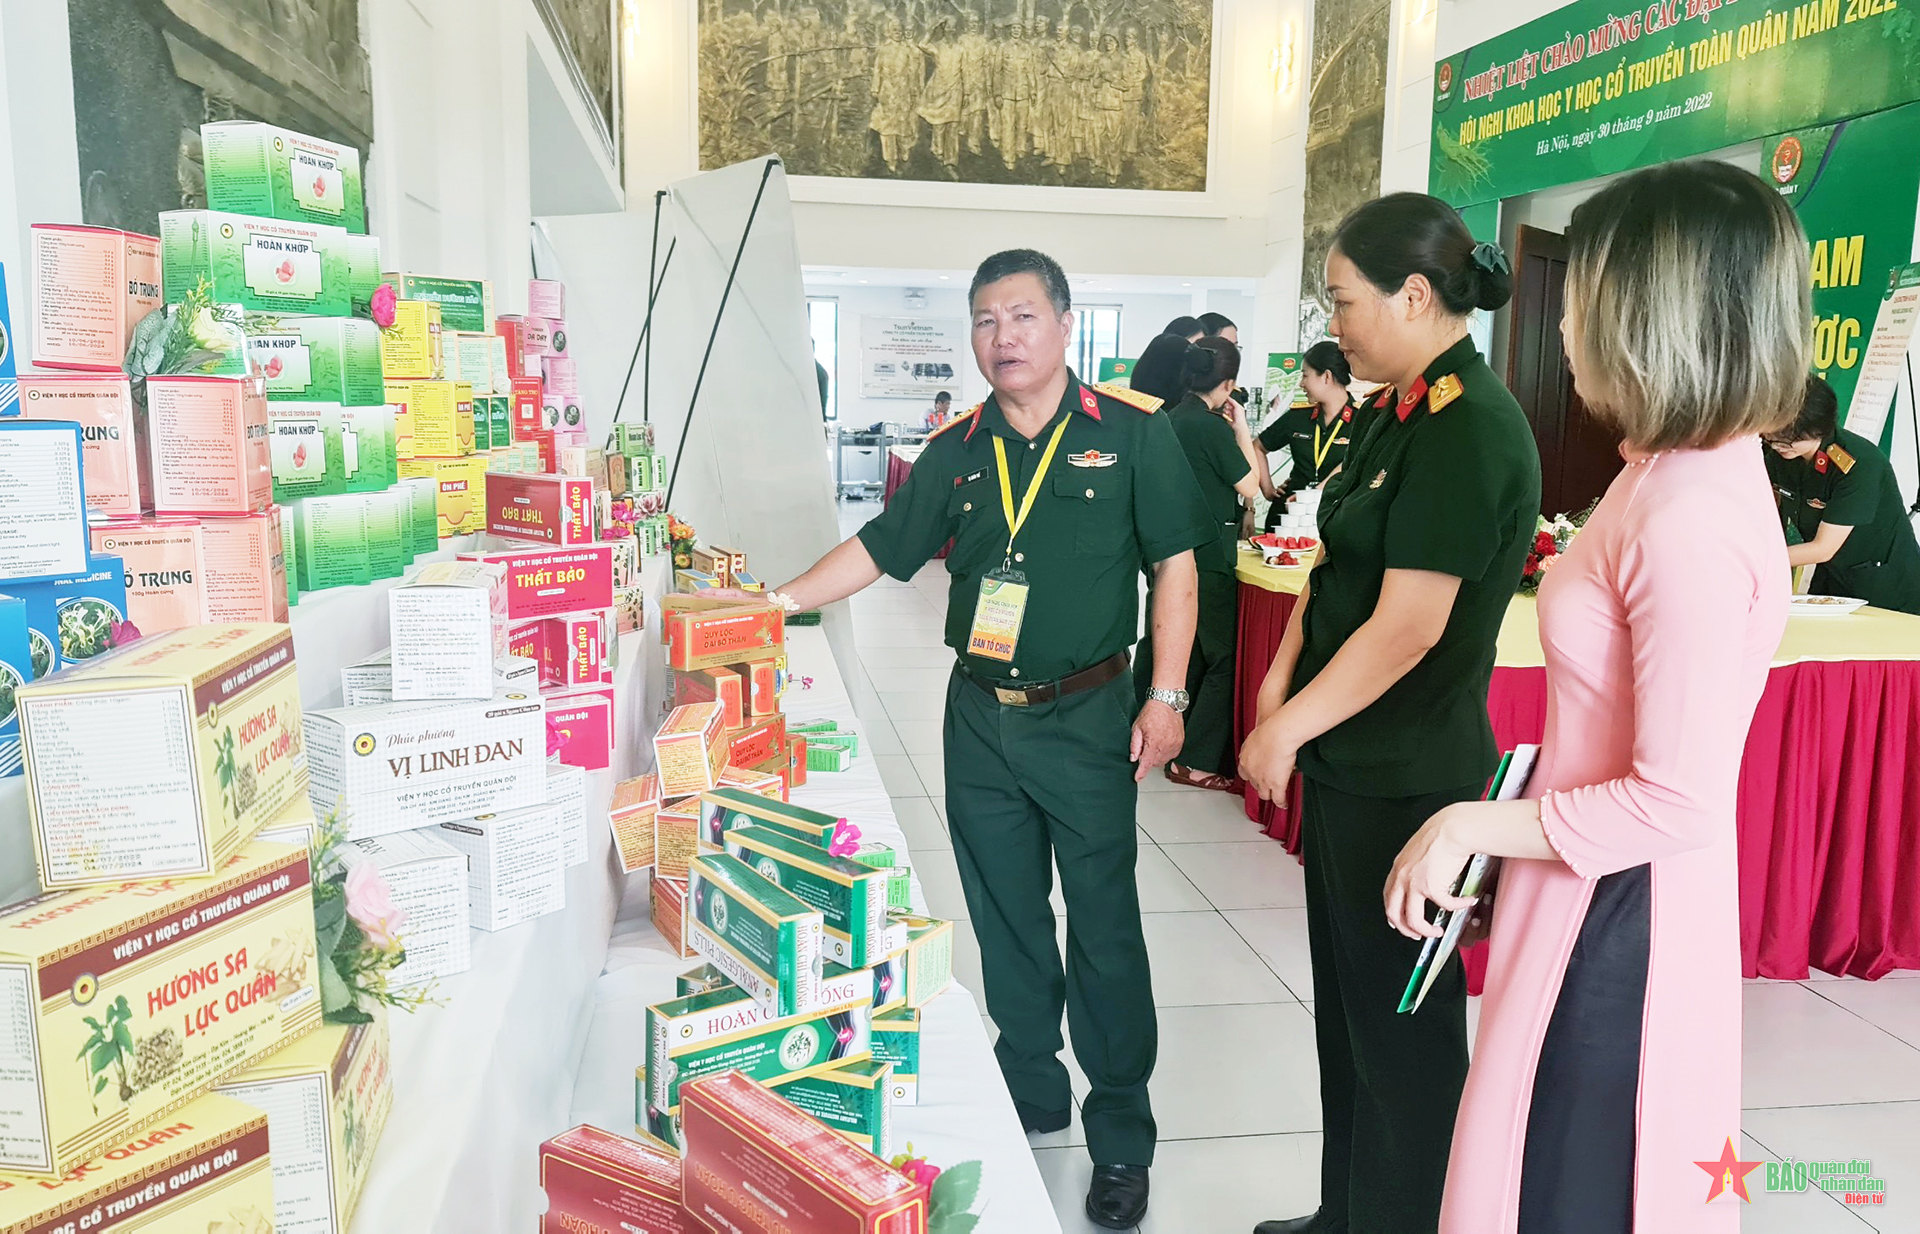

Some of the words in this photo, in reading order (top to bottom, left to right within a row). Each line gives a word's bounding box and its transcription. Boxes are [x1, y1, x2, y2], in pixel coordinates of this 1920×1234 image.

[1459, 117, 1477, 149] HỘI
[1478, 108, 1503, 140] NGHỊ
[1505, 99, 1535, 133] KHOA
[1537, 90, 1562, 125] HỌC
[1565, 86, 1574, 113] Y
[1575, 77, 1602, 114] HỌC
[1605, 56, 1627, 101] CỔ
[1627, 41, 1684, 93] TRUYỀN
[1689, 29, 1732, 73] TOÀN
[1737, 10, 1788, 60] QUÂN
[1463, 62, 1506, 103] NHIỆT
[1506, 51, 1541, 91] LIỆT
[1540, 29, 1584, 78] CHÀO
[1587, 14, 1642, 61] MỪNG
[1536, 140, 1549, 156] Hà
[1550, 136, 1570, 154] Nội,
[1571, 128, 1597, 148] ngày
[1597, 122, 1611, 139] 30
[1612, 116, 1645, 137] tháng
[1645, 109, 1654, 126] 9
[1655, 104, 1682, 123] năm
[1683, 91, 1713, 115] 2022
[1809, 235, 1864, 290] AM
[81, 426, 119, 441] RUNG
[138, 570, 192, 588] TRUNG
[515, 568, 553, 588] THẤT
[556, 566, 586, 583] BẢO
[577, 626, 587, 649] BẢO
[972, 637, 985, 649] BAN
[986, 637, 996, 651] TỔ
[994, 641, 1012, 654] CHỨC
[577, 651, 587, 678] THẤT
[238, 713, 266, 750] HƯƠNG
[267, 704, 277, 728] SA
[555, 713, 575, 724] QUÂN
[576, 711, 589, 721] ĐỘI
[255, 749, 270, 776] LỤC
[271, 731, 290, 762] QUÂN
[386, 733, 415, 748] Phúc
[387, 755, 412, 780] VỊ
[419, 746, 470, 774] LINH
[474, 738, 524, 764] ĐAN
[396, 792, 414, 803] VIỆN
[423, 788, 439, 798] HỌC
[441, 784, 451, 794] CỔ
[453, 780, 482, 792] TRUYỀN
[483, 776, 503, 787] QUÂN
[504, 775, 517, 784] ĐỘI
[113, 937, 143, 961] VIỆN
[144, 932, 153, 947] Y
[155, 921, 180, 943] HỌC
[182, 909, 198, 931] CỔ
[199, 895, 242, 923] TRUYỀN
[242, 881, 272, 905] QUÂN
[272, 874, 290, 893] ĐỘI
[694, 930, 715, 957] PILLS
[796, 924, 808, 956] HOÀN
[147, 961, 219, 1018] HƯƠNG
[224, 947, 248, 978] SA
[715, 946, 759, 993] ANALGESIC
[184, 1000, 219, 1038] LỤC
[225, 971, 277, 1014] QUÂN
[708, 1007, 759, 1035] HOÀN
[37, 1160, 103, 1190] LỤC
[103, 1122, 195, 1161] QUÂN
[79, 1204, 103, 1231] CỔ
[106, 1181, 166, 1218] TRUYỀN
[169, 1162, 211, 1190] QUÂN
[213, 1149, 238, 1171] ĐỘI
